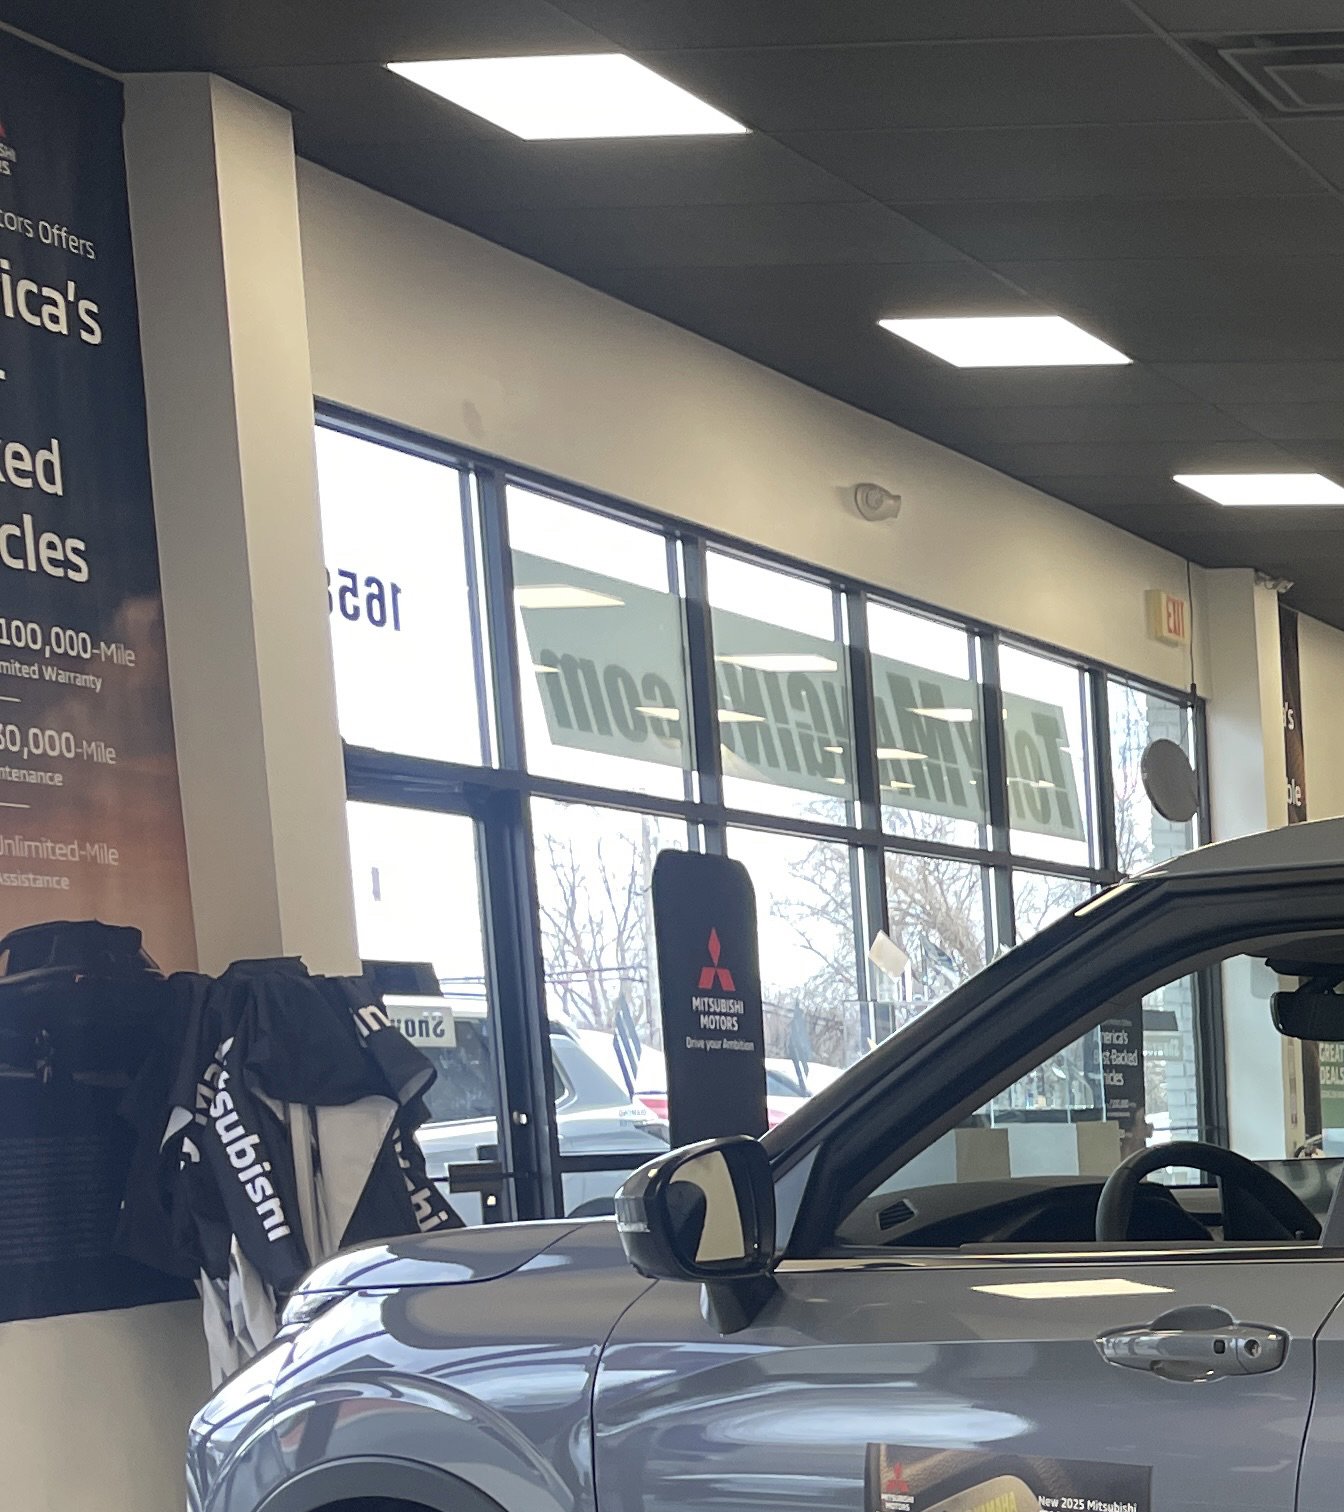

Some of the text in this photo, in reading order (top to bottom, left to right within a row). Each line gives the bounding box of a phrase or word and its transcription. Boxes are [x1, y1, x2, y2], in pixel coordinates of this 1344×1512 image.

[38, 220, 97, 260] Offers
[0, 258, 103, 345] ica's
[0, 513, 90, 583] cles
[1166, 595, 1185, 638] EXIT
[0, 660, 102, 693] mited Warranty
[0, 766, 64, 786] ntenance
[692, 997, 744, 1014] MITSUBISHI
[700, 1014, 738, 1031] MOTORS
[1320, 1043, 1344, 1062] GREAT
[1320, 1066, 1344, 1085] DEALS
[1038, 1495, 1060, 1507] New
[1061, 1498, 1085, 1510] 2025
